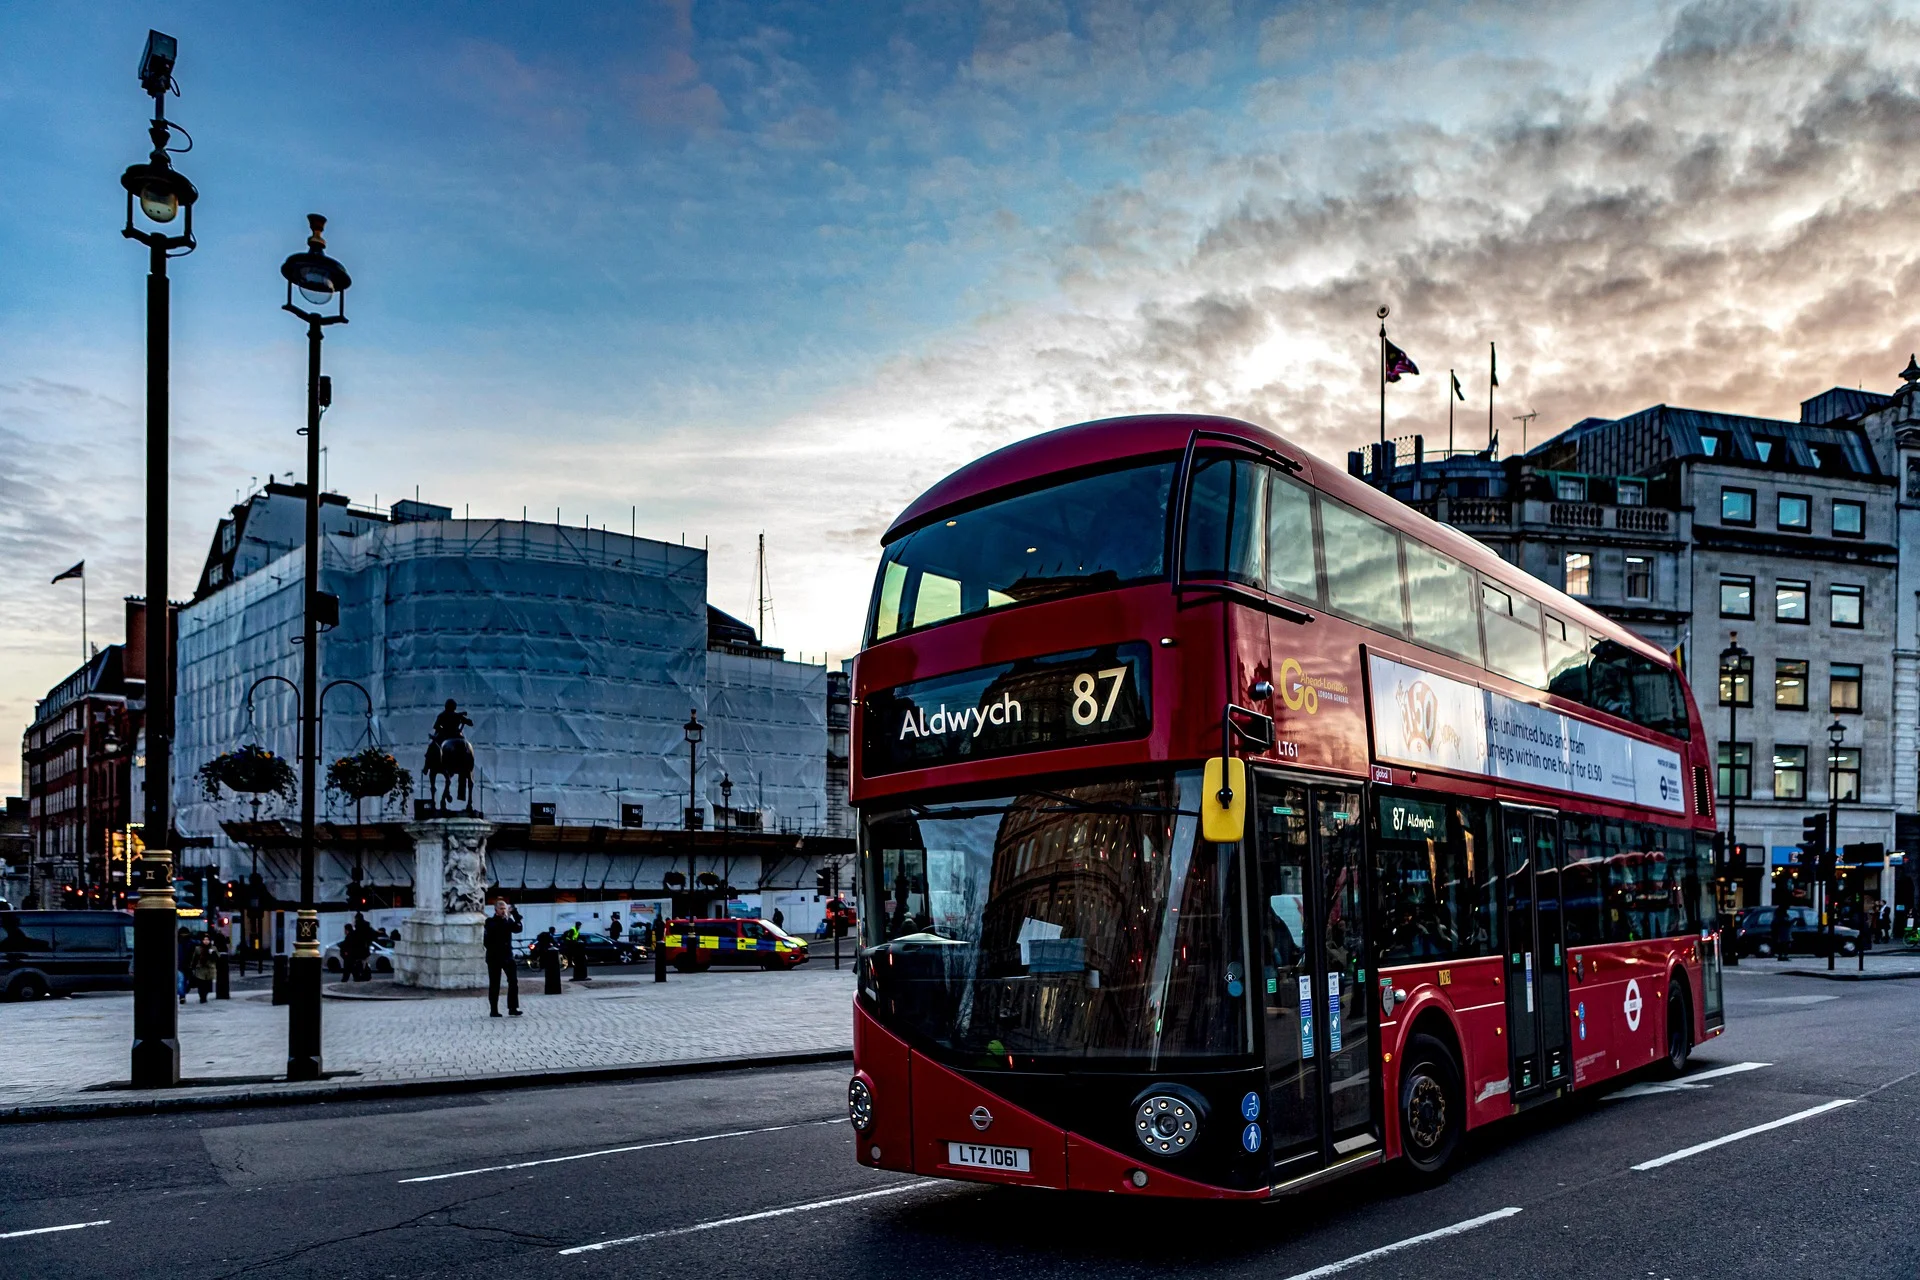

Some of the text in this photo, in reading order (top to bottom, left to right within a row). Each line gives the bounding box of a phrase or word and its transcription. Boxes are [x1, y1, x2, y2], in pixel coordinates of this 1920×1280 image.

[1300, 673, 1348, 694] Ahead-London
[899, 666, 1128, 741] Aldwych 87
[1278, 740, 1299, 757] LT61
[1501, 717, 1538, 743] unlimited
[1540, 727, 1553, 748] bus
[1570, 736, 1586, 756] tram
[1515, 747, 1542, 769] within
[1543, 756, 1557, 773] one
[1558, 756, 1575, 775] hour
[1576, 760, 1586, 779] for
[1587, 762, 1603, 782] £1.50
[1393, 806, 1434, 832] 87 Aldwych
[959, 1145, 1018, 1168] LTZ 1061
